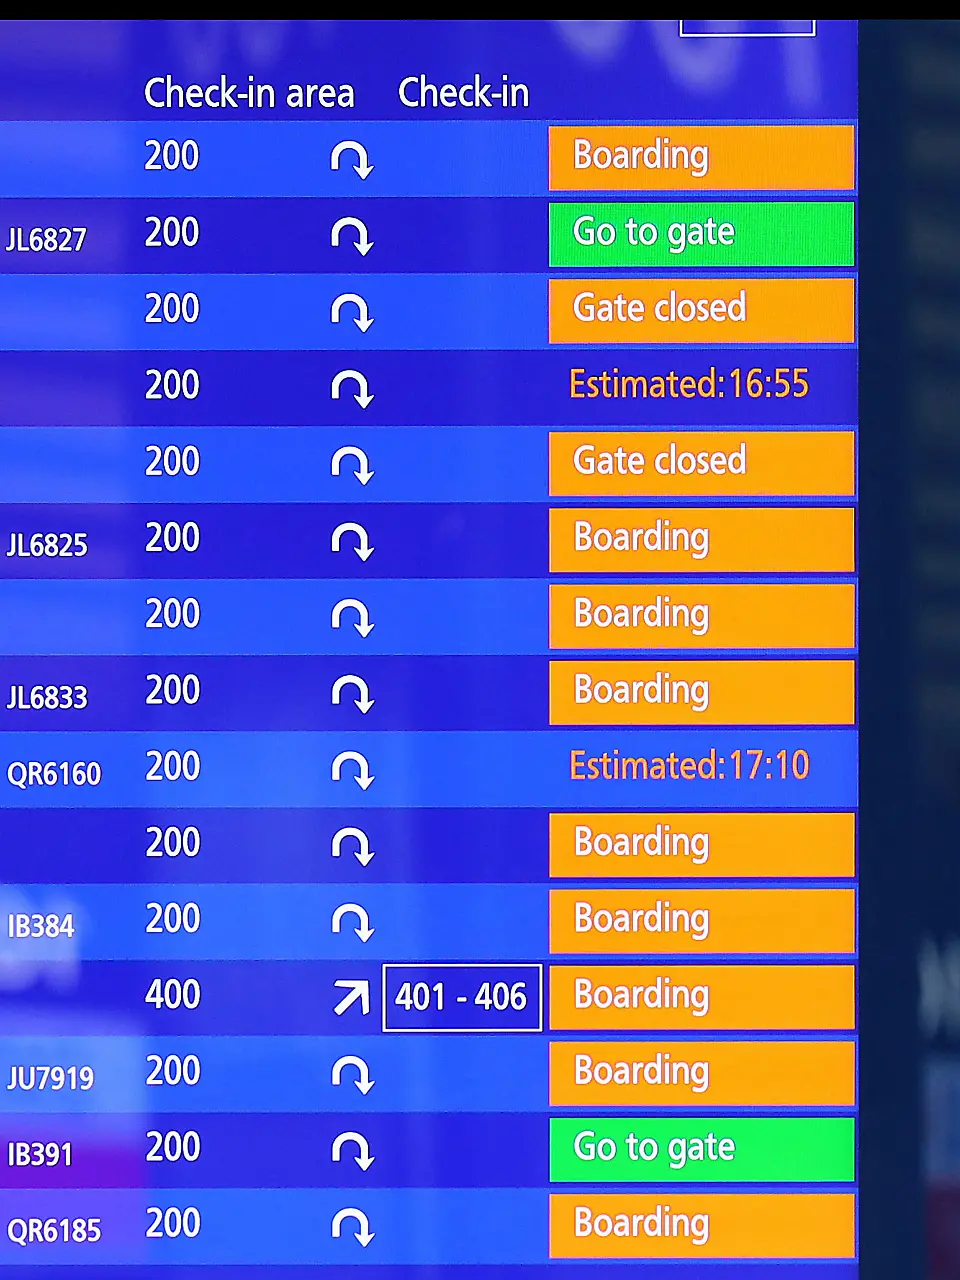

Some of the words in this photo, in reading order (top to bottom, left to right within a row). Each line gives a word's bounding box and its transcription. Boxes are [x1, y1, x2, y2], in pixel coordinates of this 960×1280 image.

[144, 74, 275, 108] Check-in
[286, 84, 355, 108] area
[398, 73, 529, 108] Check-in
[144, 139, 199, 170] 200
[574, 137, 710, 178] Boarding
[5, 227, 87, 252] JL6827
[145, 216, 199, 247] 200
[573, 215, 616, 246] Go
[624, 217, 658, 246] to
[667, 217, 735, 254] gate
[145, 292, 200, 323] 200
[573, 291, 646, 322] Gate
[654, 289, 747, 322] closed
[145, 368, 200, 400] 200
[570, 366, 809, 399] Estimated:16:55
[145, 445, 200, 476] 200
[573, 444, 646, 475] Gate
[654, 442, 747, 475] closed
[6, 532, 88, 557] JL6825
[145, 521, 200, 552] 200
[574, 519, 710, 560] Boarding
[145, 597, 200, 628] 200
[574, 595, 710, 636] Boarding
[6, 685, 88, 710] JL6833
[145, 673, 200, 705] 200
[574, 671, 710, 712] Boarding
[7, 761, 102, 790] QR6160
[146, 750, 200, 781] 200
[570, 748, 810, 780] Estimated:17:10
[146, 826, 200, 857] 200
[574, 824, 710, 865] Boarding
[8, 914, 75, 938] IB384
[145, 902, 200, 933] 200
[574, 900, 710, 941] Boarding
[144, 978, 201, 1009] 400
[394, 982, 443, 1011] 401
[474, 981, 527, 1011] 406
[574, 977, 710, 1018] Boarding
[7, 1066, 94, 1090] JU7919
[146, 1054, 201, 1086] 200
[574, 1053, 710, 1094] Boarding
[8, 1142, 71, 1166] IB391
[146, 1130, 201, 1162] 200
[573, 1130, 617, 1161] Go
[625, 1132, 659, 1161] to
[668, 1132, 736, 1169] gate
[7, 1218, 101, 1246] QR6185
[146, 1206, 201, 1238] 200
[574, 1206, 710, 1247] Boarding
